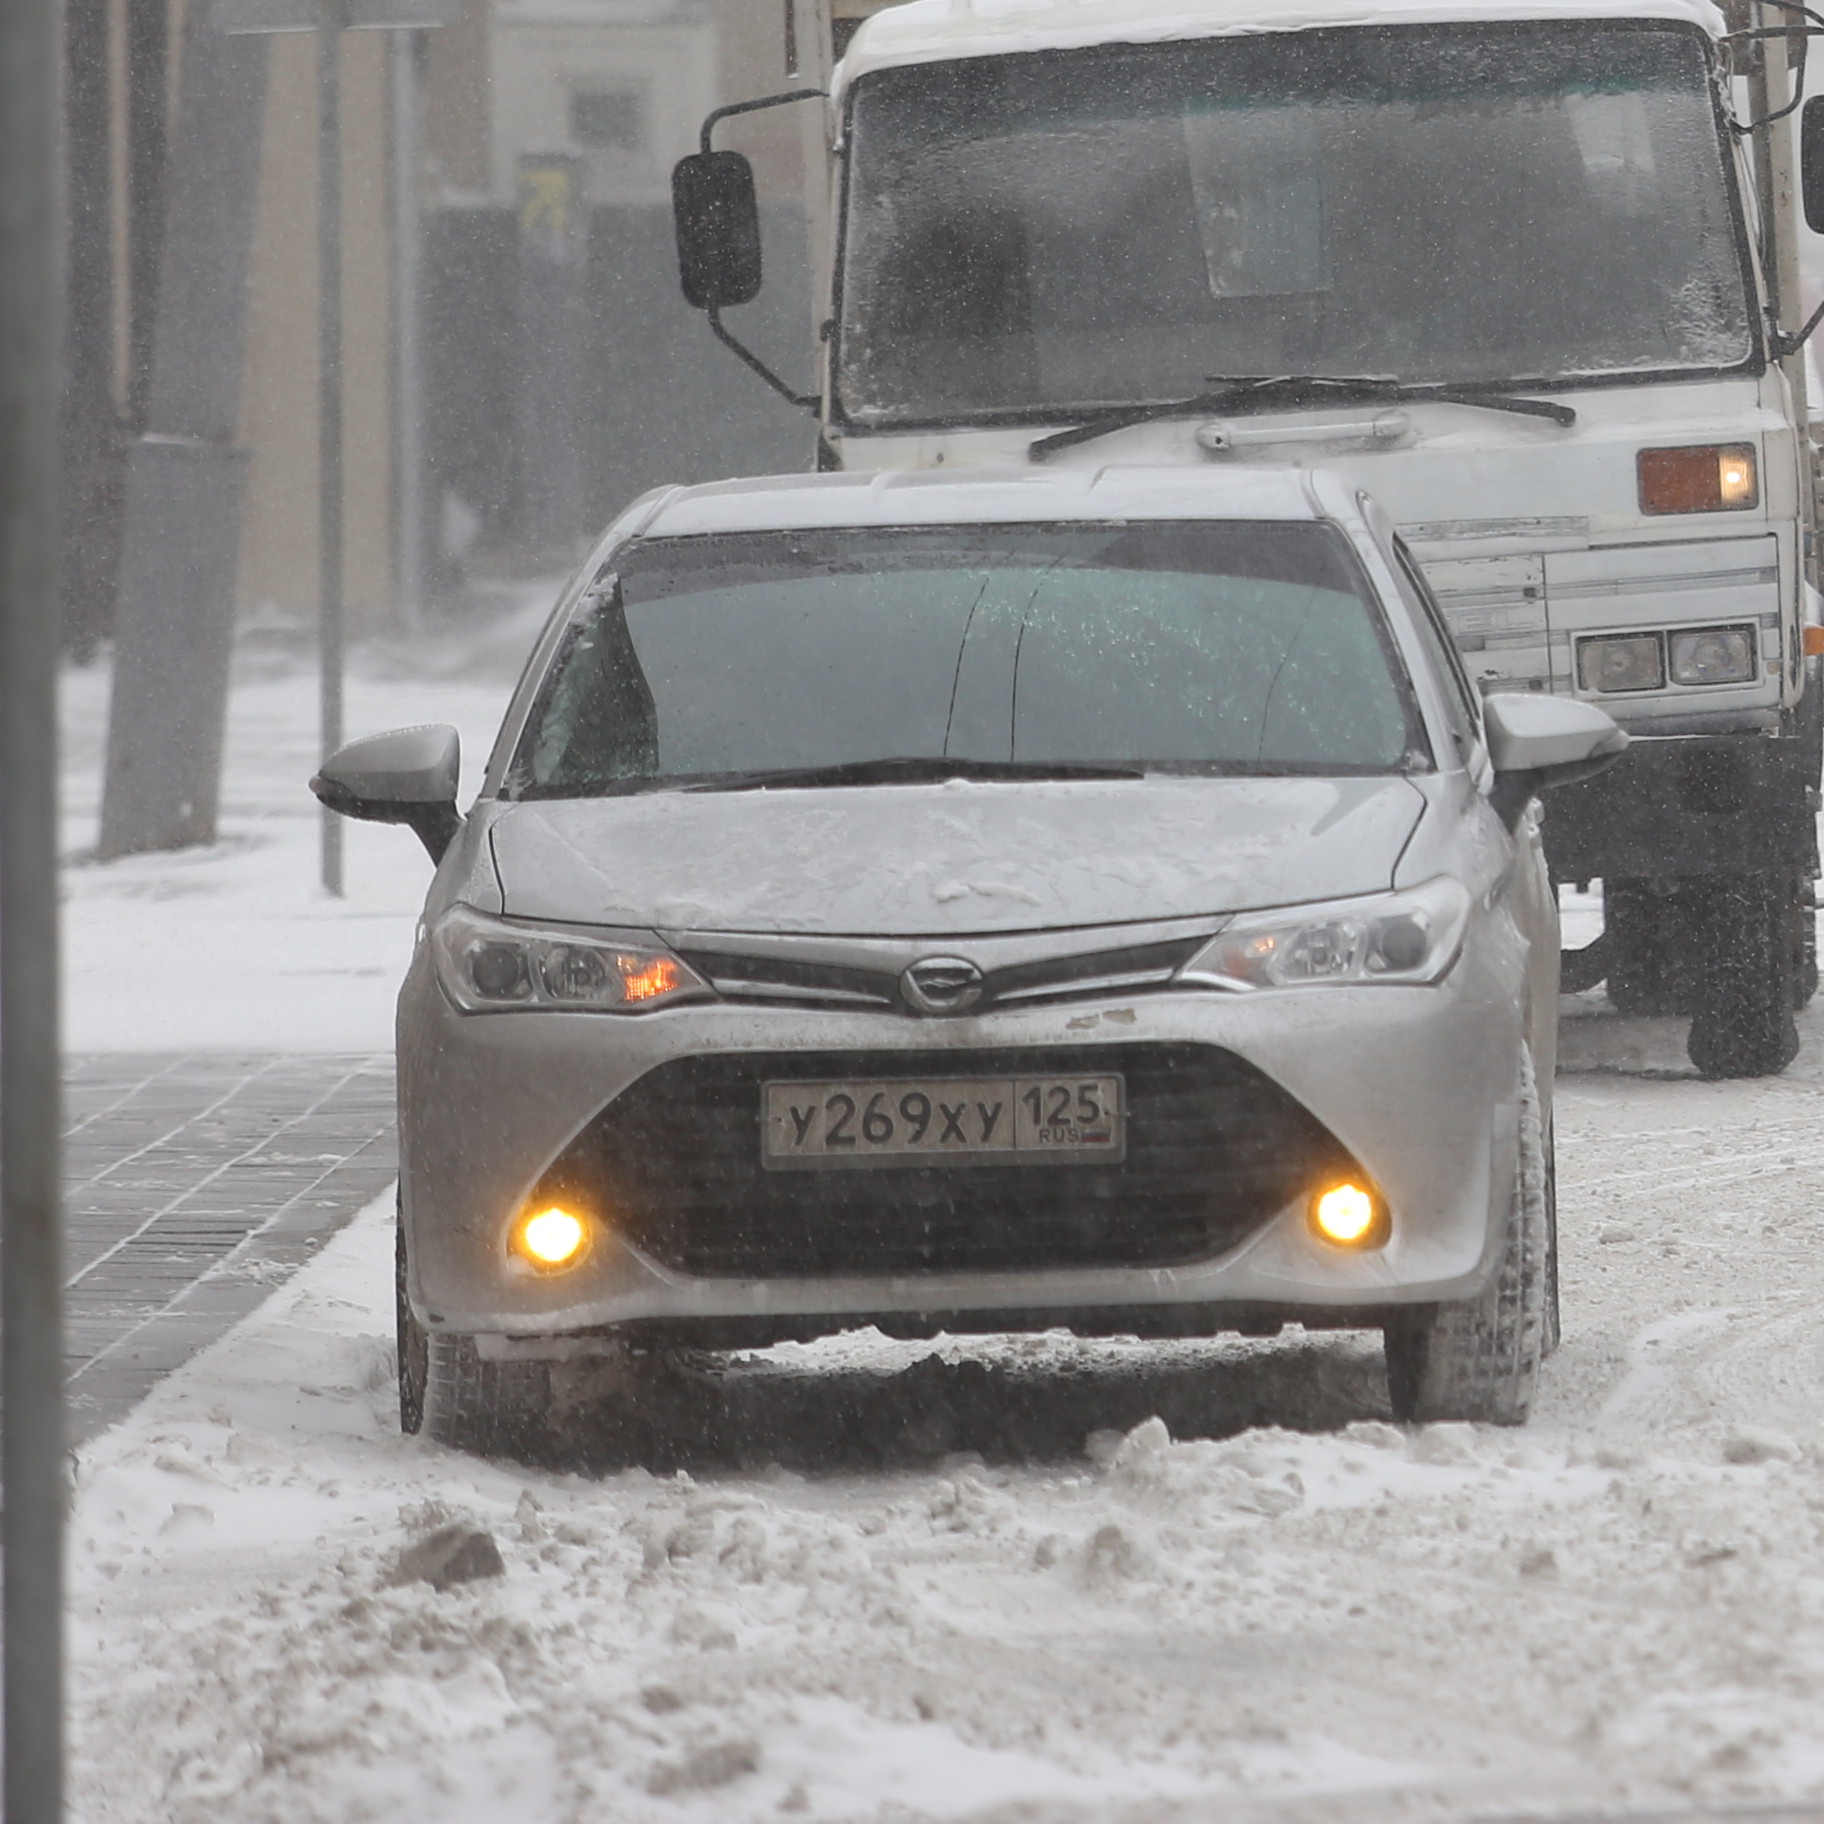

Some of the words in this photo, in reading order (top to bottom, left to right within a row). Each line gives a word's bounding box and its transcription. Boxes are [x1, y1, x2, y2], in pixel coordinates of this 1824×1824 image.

[789, 1091, 1003, 1147] У269ХУ
[1021, 1083, 1100, 1127] 125
[1038, 1128, 1081, 1144] RUS
